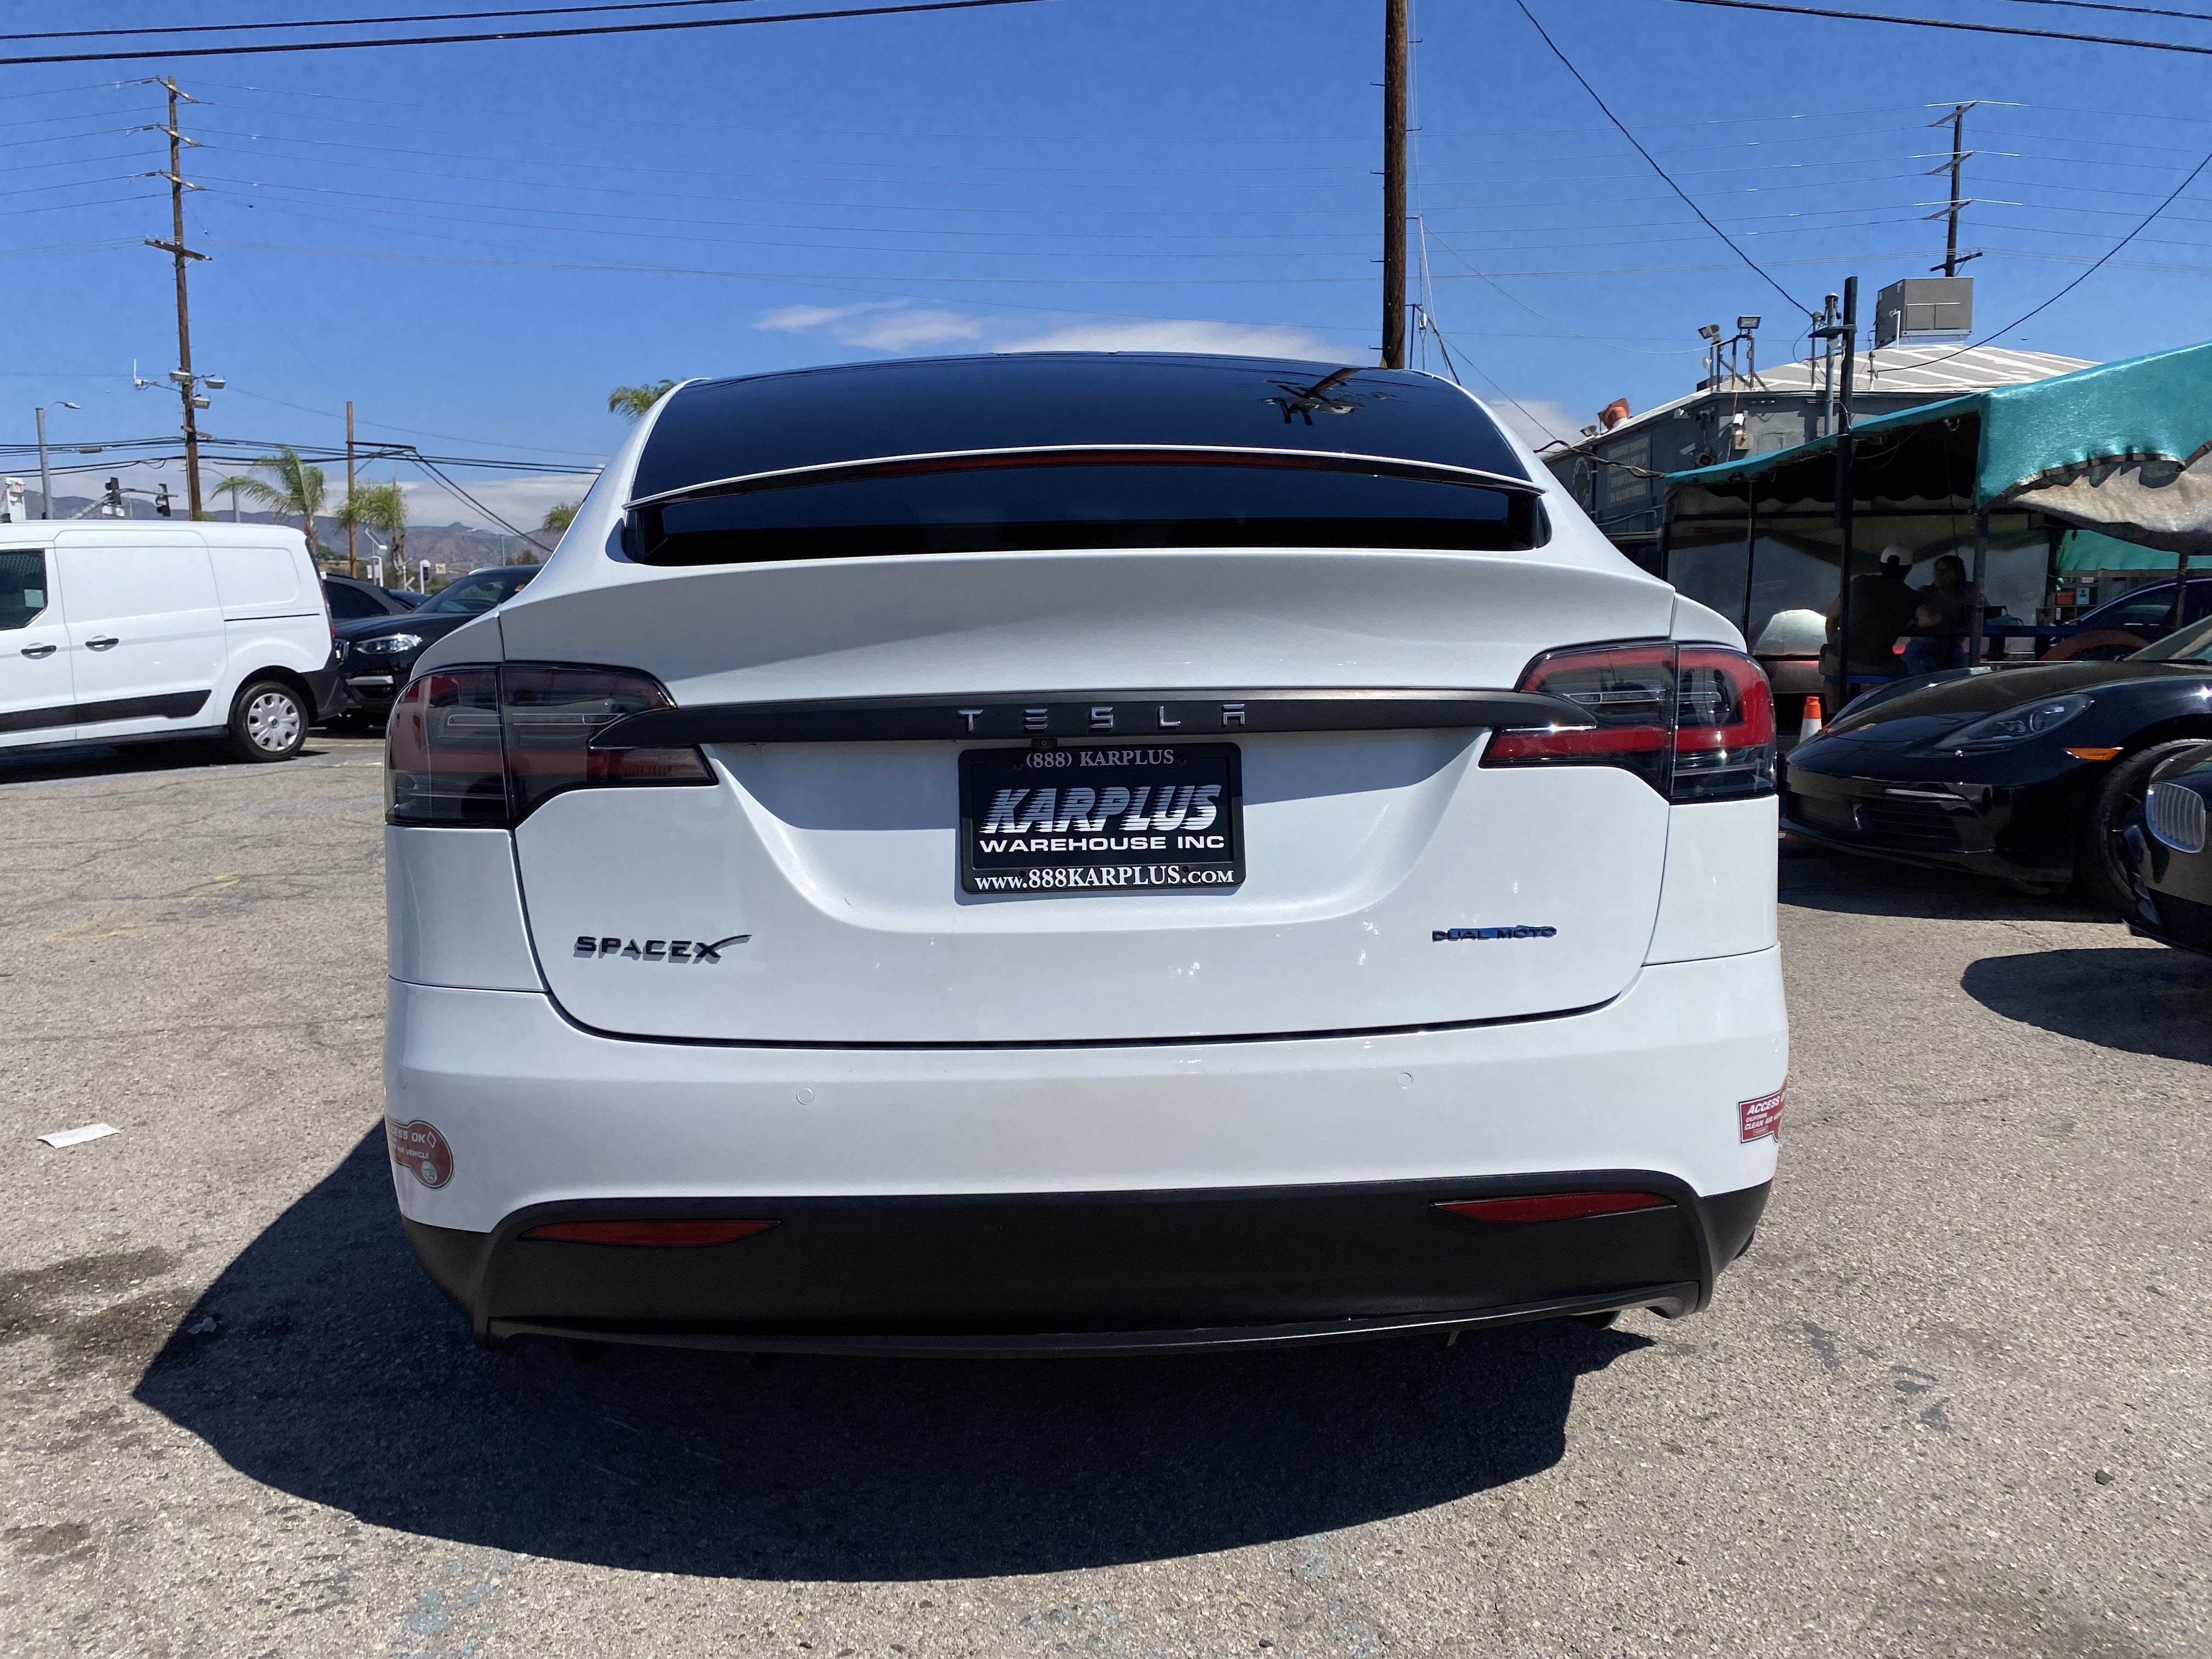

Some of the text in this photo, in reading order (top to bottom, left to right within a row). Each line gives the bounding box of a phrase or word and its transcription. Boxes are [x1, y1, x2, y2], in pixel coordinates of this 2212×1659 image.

[957, 703, 1245, 731] TESLA
[1026, 749, 1175, 768] (888) KARPLUS
[979, 785, 1222, 834] KARPLUS
[979, 836, 1225, 853] WAREHOUSE INC
[577, 934, 752, 958] SPACEX
[1747, 1096, 1780, 1115] ACCESS
[1745, 1119, 1764, 1131] CLEAN
[1765, 1116, 1773, 1125] AIR
[411, 1132, 426, 1144] OK
[406, 1149, 430, 1160] VEHICLE
